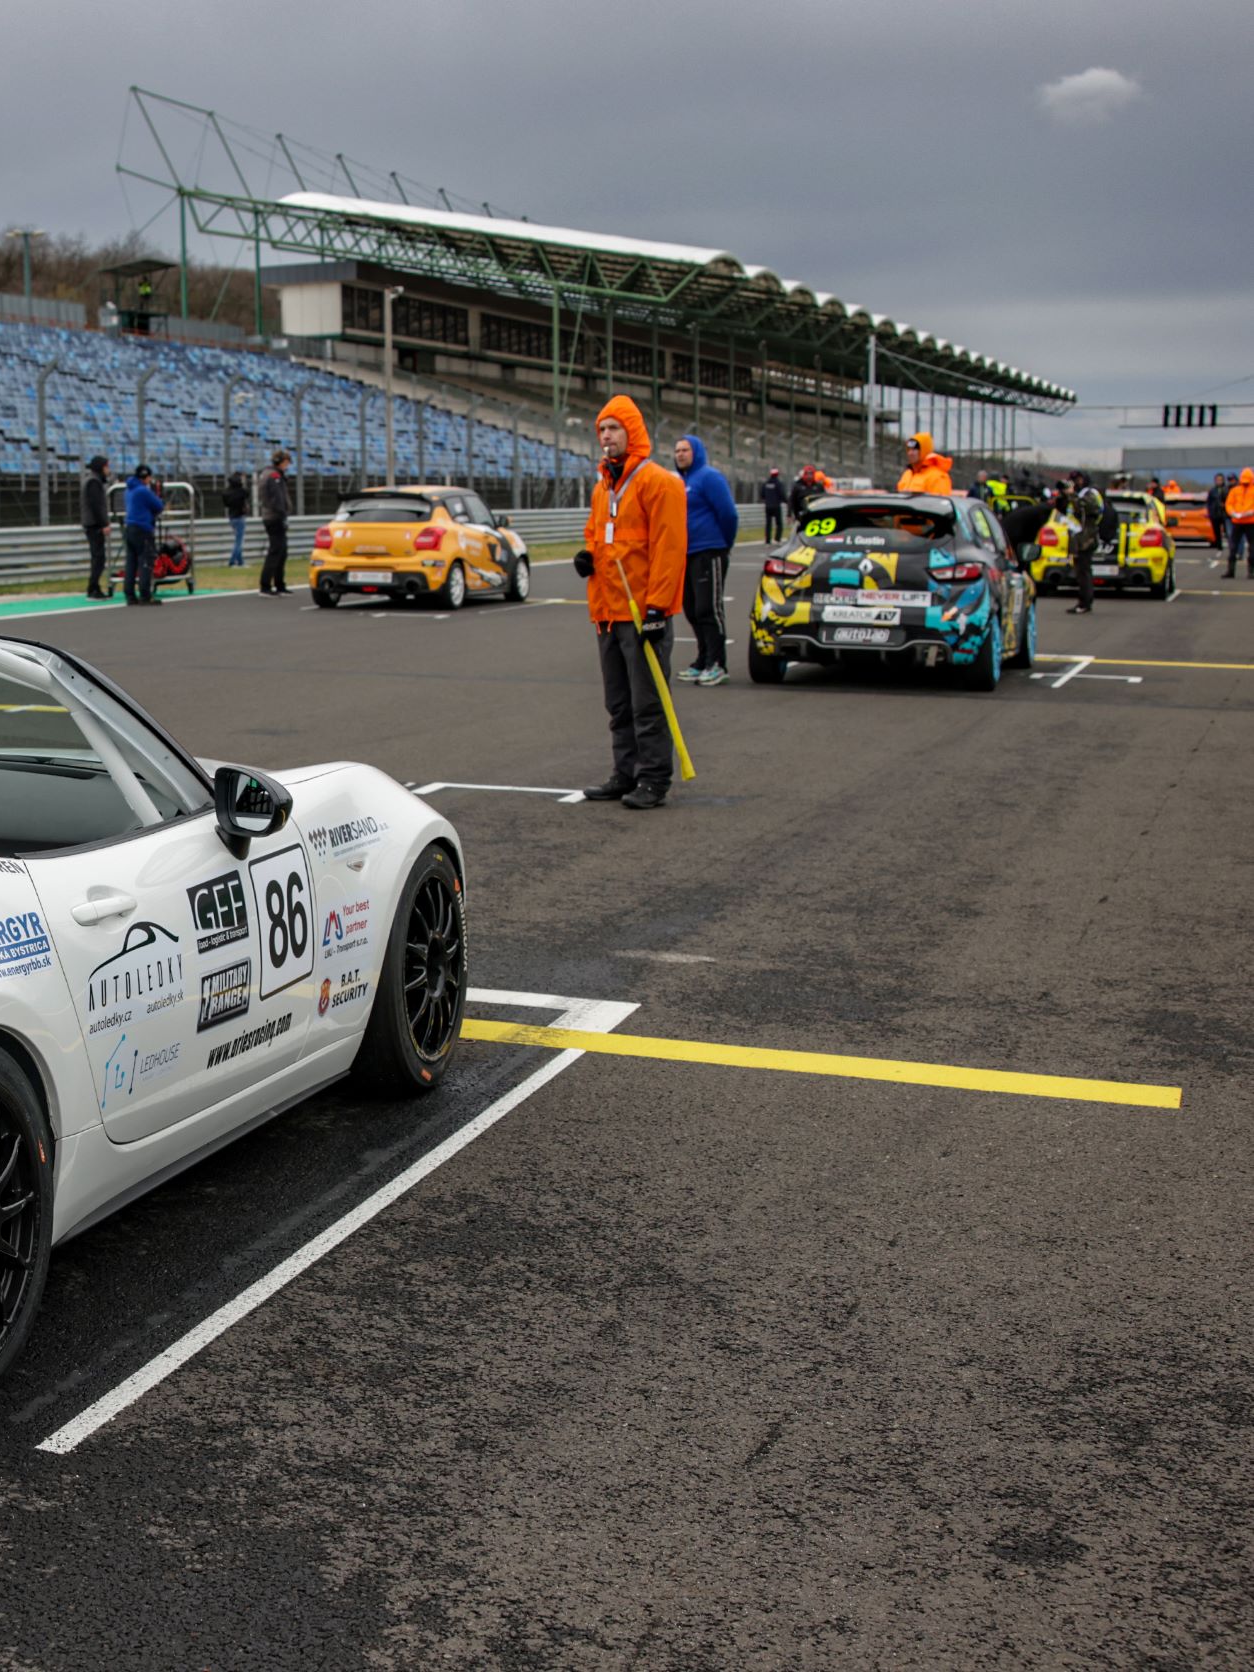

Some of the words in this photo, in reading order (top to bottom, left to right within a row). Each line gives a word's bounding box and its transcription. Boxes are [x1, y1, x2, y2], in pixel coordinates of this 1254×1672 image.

[805, 517, 836, 537] 69
[861, 591, 900, 600] NEVER
[902, 592, 929, 601] LIFT
[328, 816, 378, 848] RIVERSAND
[265, 871, 308, 969] 86
[342, 903, 354, 917] Your
[355, 899, 369, 913] best
[346, 919, 368, 937] partner
[10, 940, 49, 958] BYSTRICA
[89, 954, 182, 1012] AUTOLEDKY
[212, 964, 248, 993] MILITARY
[341, 969, 361, 987] B.A.T.
[146, 988, 184, 1014] autoledky.sk
[211, 986, 243, 1016] RANGE
[331, 982, 368, 1008] SECURITY
[89, 1010, 132, 1035] autoledky.cz
[207, 1012, 292, 1069] www.ariesracing.com
[140, 1043, 181, 1074] LEDHOUSE
